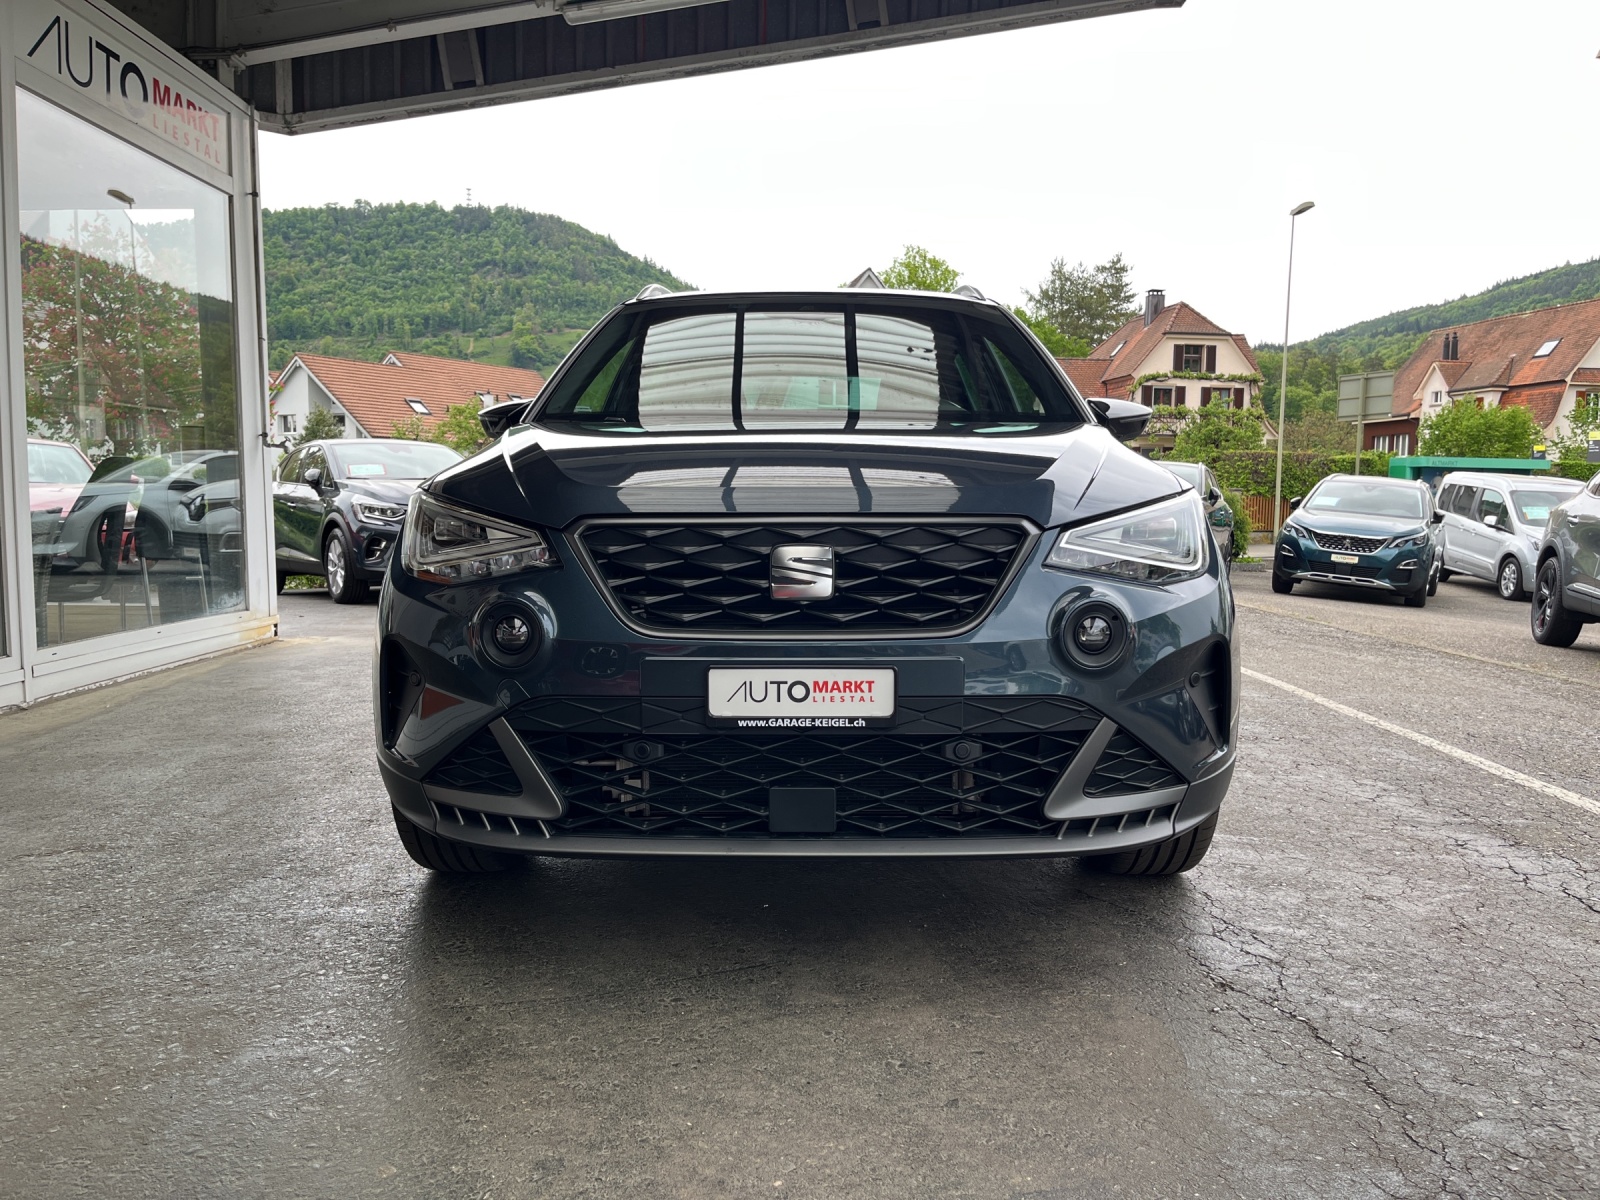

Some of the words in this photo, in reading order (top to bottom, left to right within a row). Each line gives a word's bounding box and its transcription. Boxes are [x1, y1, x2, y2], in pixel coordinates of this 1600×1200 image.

[27, 15, 149, 119] AUTO
[152, 77, 220, 142] MARKT
[152, 113, 221, 165] LIESTAL
[727, 680, 810, 703] AUTO
[812, 680, 875, 693] MARKT
[812, 695, 875, 703] LIESTAL
[737, 718, 866, 728] www.GARAGE-KEIGEL.ch
